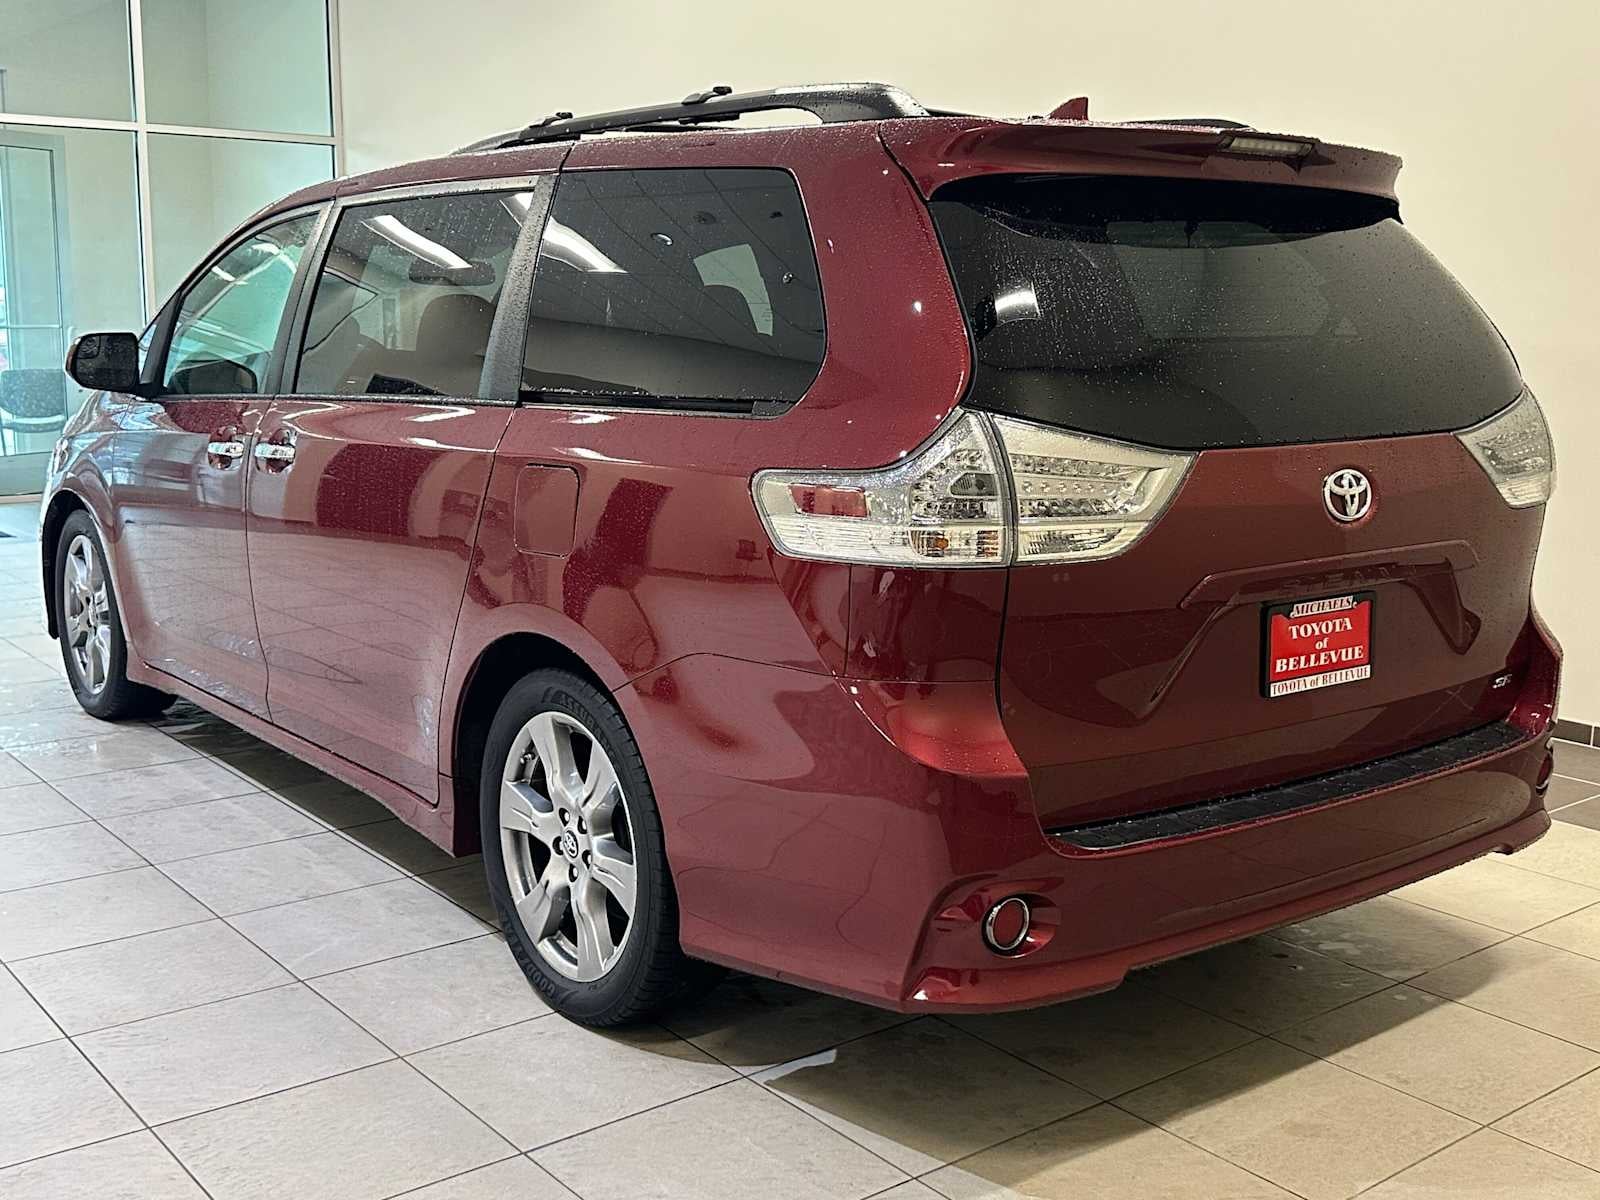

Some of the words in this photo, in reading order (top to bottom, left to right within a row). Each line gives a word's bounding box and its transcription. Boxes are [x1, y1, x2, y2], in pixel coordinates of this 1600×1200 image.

[1289, 617, 1352, 640] TOYOTA
[1315, 638, 1329, 650] of
[1275, 645, 1364, 673] BELLEVUE
[1272, 679, 1308, 695] TOYOTA
[1310, 677, 1320, 687] of
[1322, 667, 1369, 682] BELLEVUE
